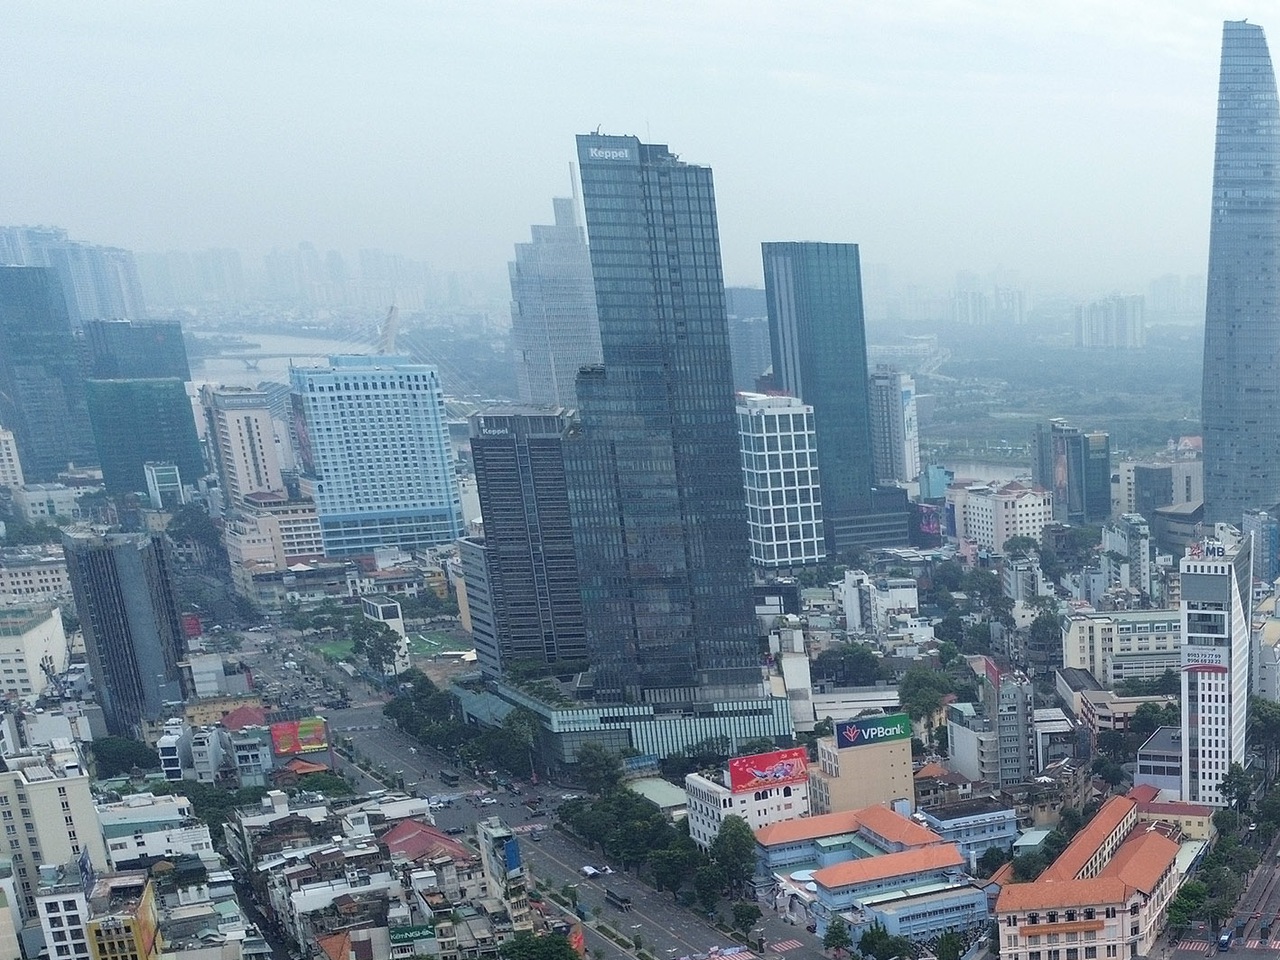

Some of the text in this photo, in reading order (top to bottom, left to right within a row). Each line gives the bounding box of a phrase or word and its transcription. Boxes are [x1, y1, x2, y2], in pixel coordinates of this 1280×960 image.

[590, 147, 629, 160] Keppel
[1205, 546, 1225, 557] MB
[862, 723, 905, 739] VPBank
